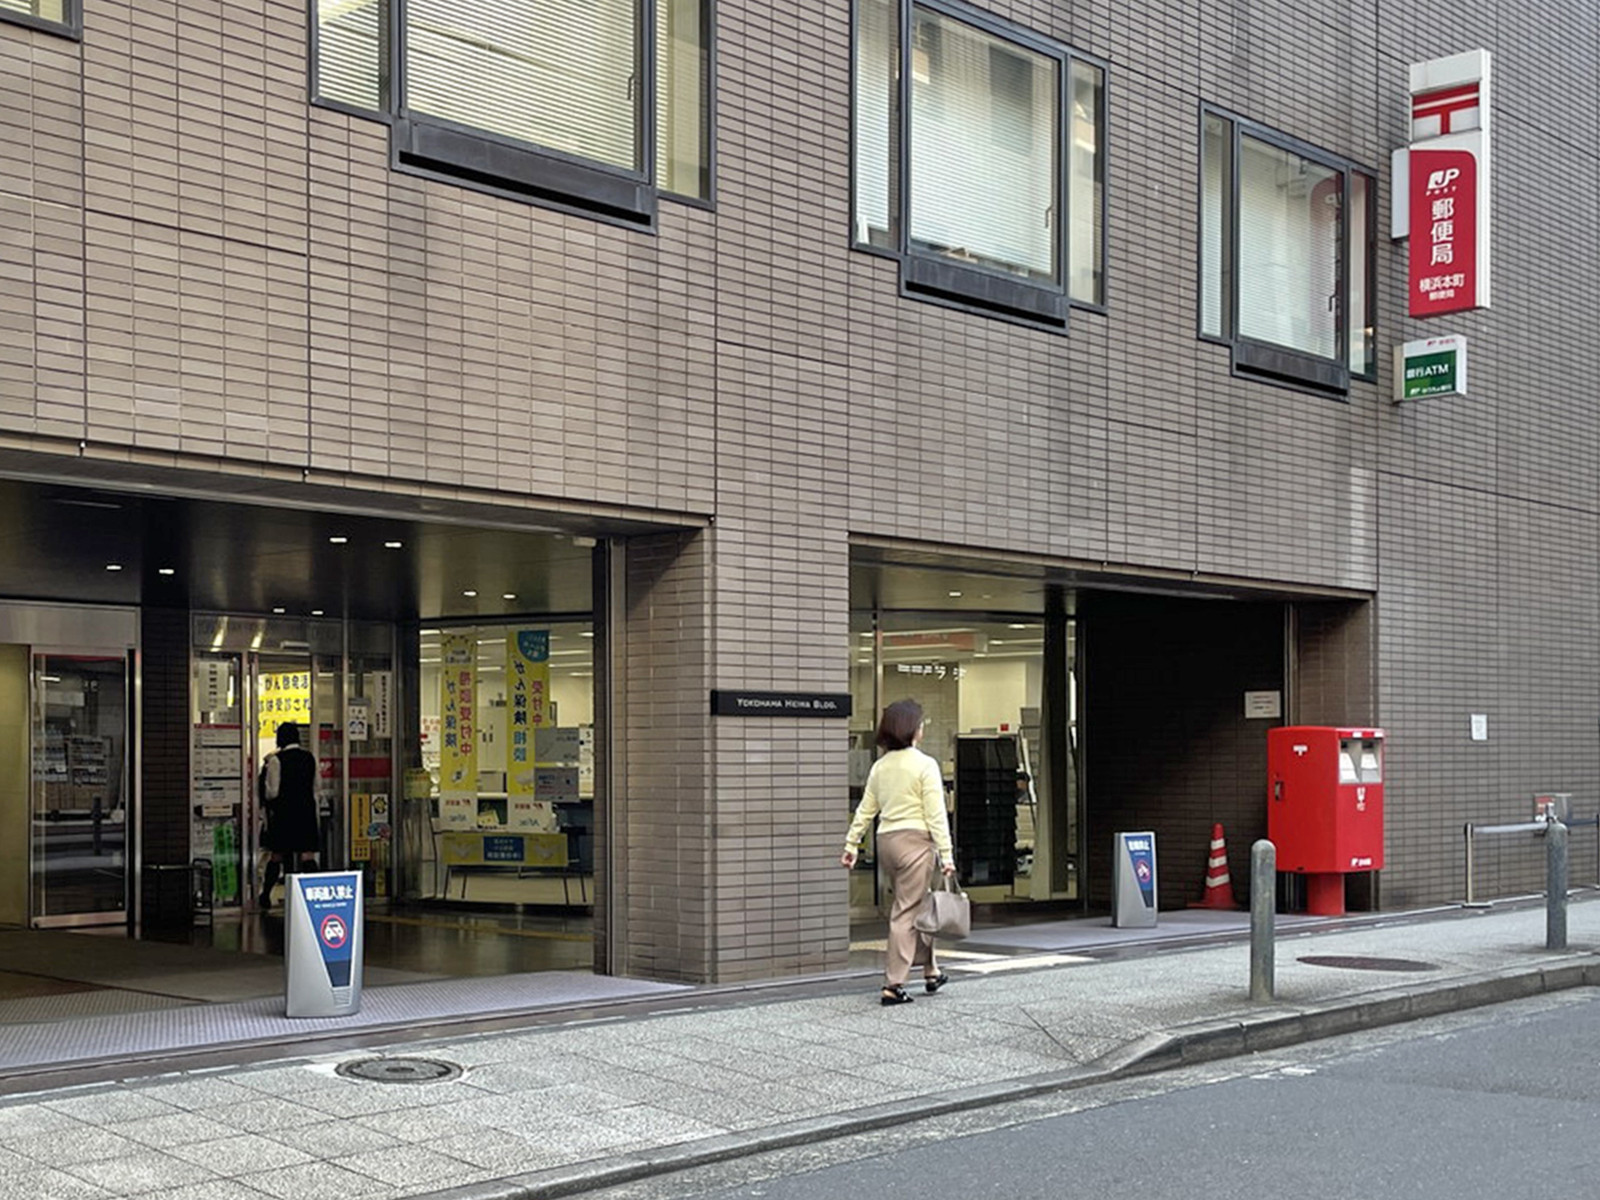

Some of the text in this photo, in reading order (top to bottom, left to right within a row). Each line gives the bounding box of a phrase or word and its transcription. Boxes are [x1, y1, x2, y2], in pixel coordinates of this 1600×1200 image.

[1427, 169, 1460, 190] JP
[1430, 198, 1454, 266] 郵便局
[1419, 273, 1465, 293] 横浜本町
[736, 698, 782, 708] YOKOHAMA
